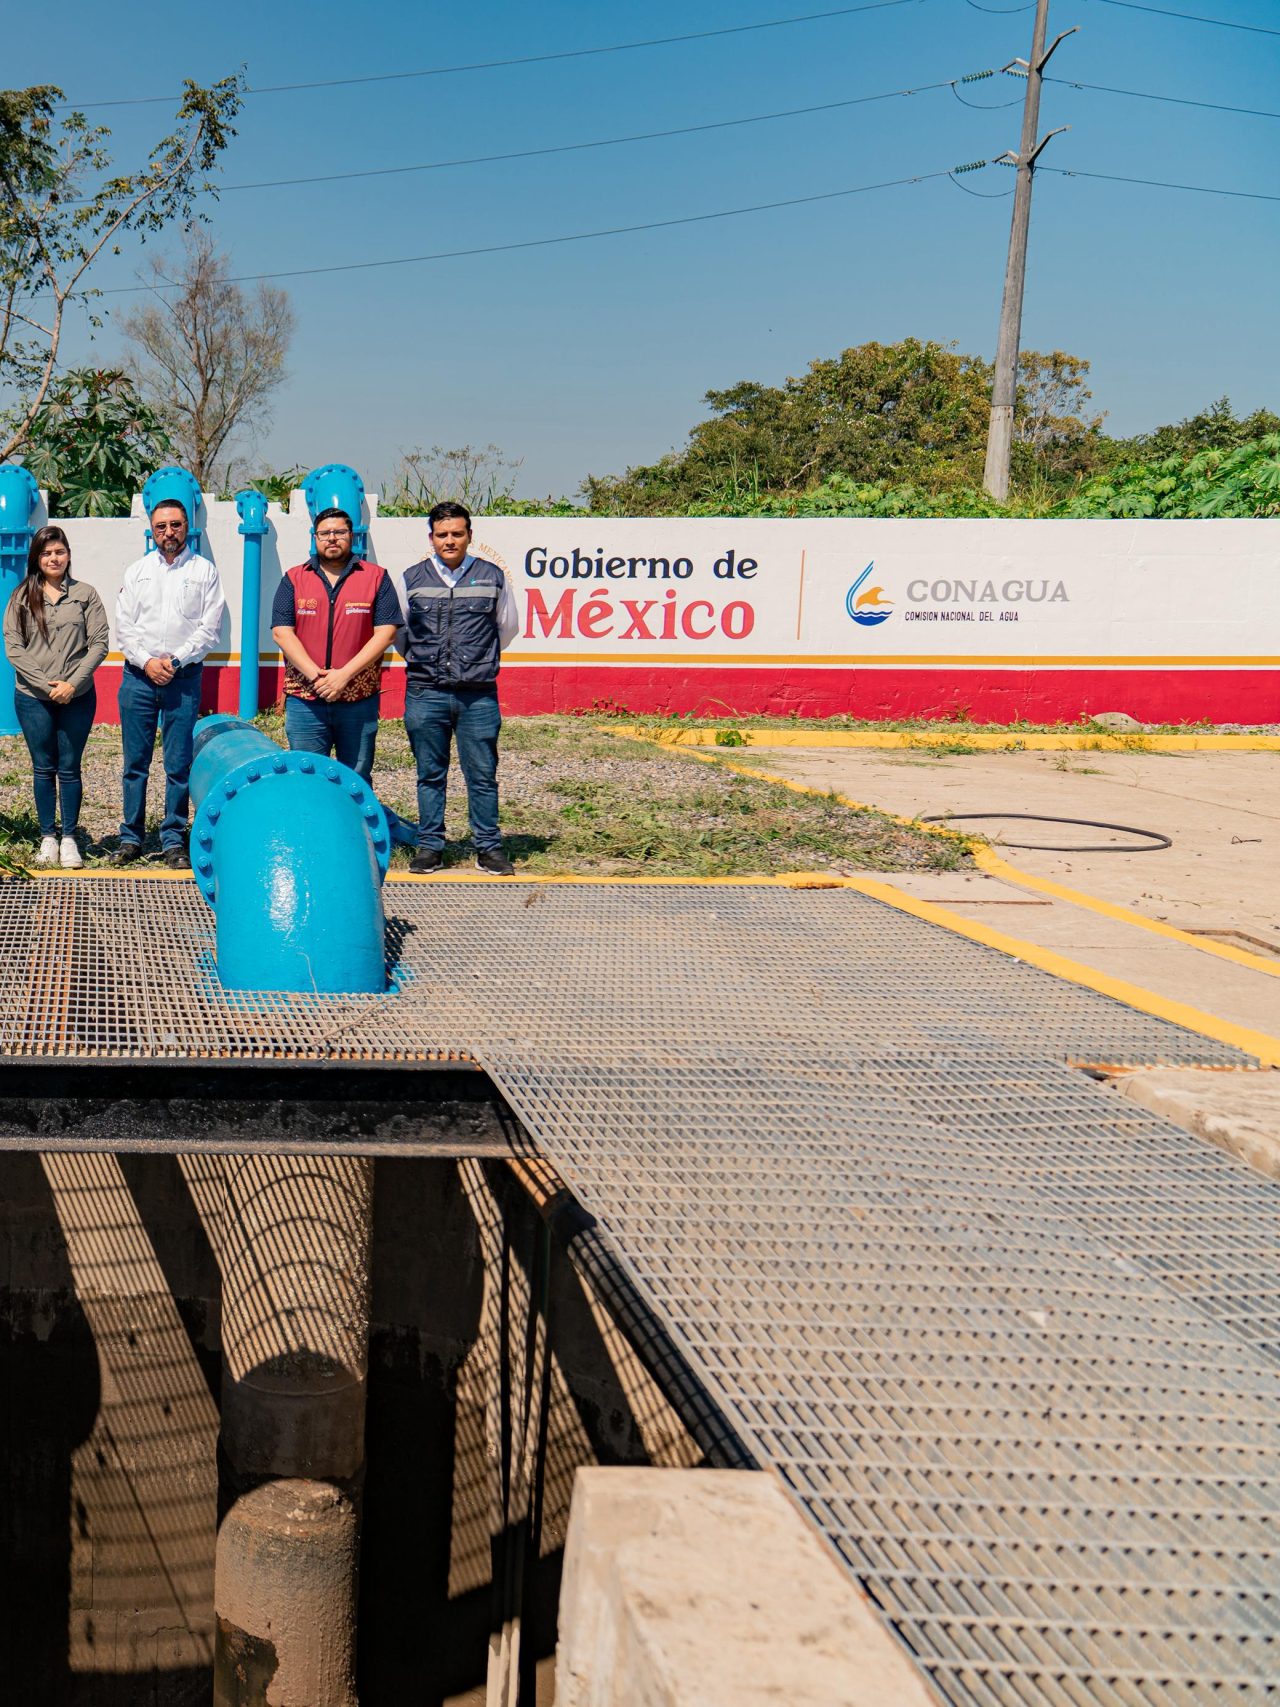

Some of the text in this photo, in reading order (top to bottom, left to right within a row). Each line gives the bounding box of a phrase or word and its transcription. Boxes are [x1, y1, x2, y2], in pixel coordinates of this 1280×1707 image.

[479, 543, 513, 587] MEXICANO
[524, 547, 758, 580] Gobierno de
[906, 579, 1071, 603] CONAGUA
[522, 588, 755, 640] México
[904, 611, 1019, 622] COMISION NACIONAL DEL AGUA
